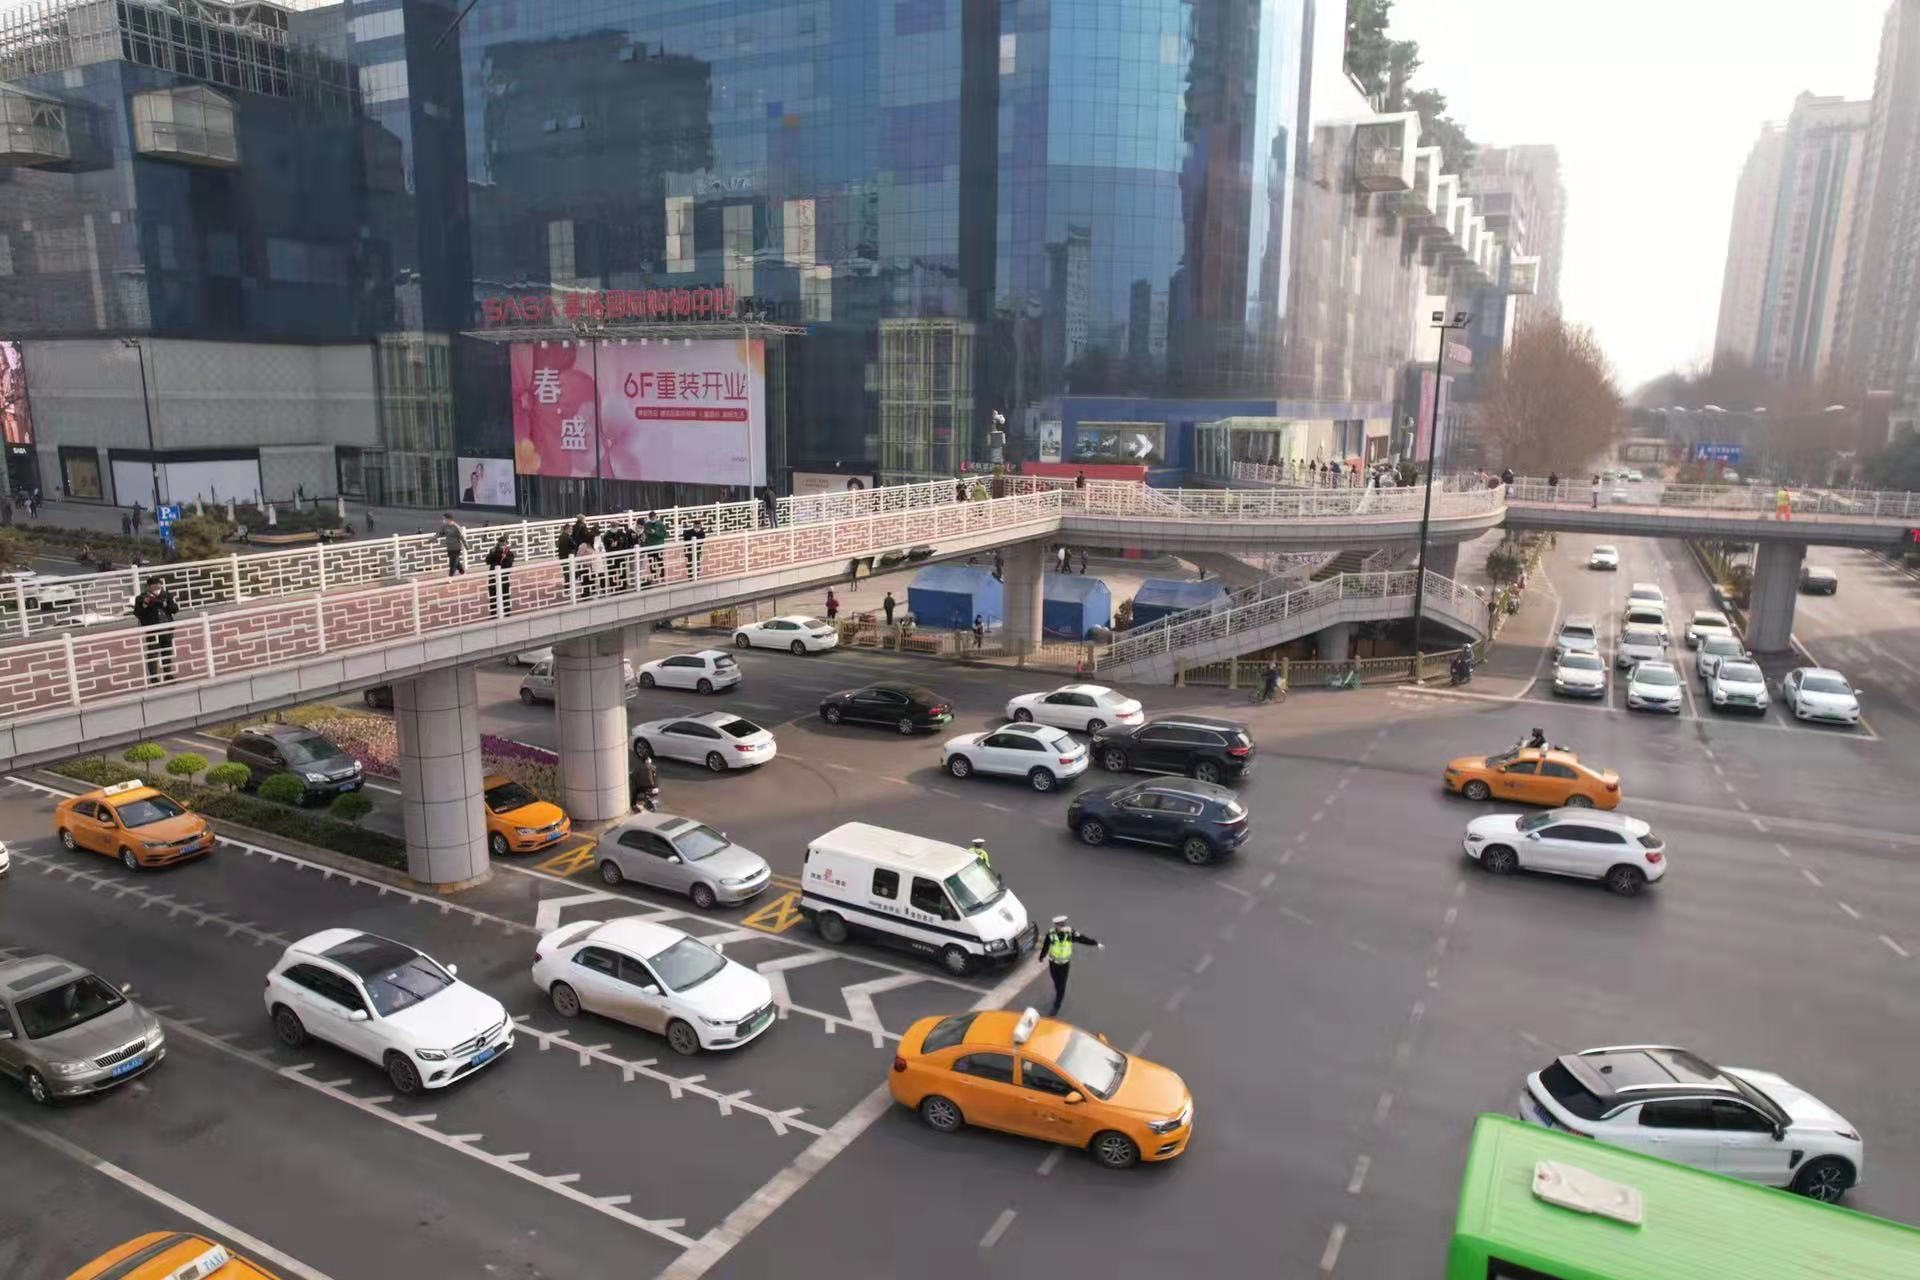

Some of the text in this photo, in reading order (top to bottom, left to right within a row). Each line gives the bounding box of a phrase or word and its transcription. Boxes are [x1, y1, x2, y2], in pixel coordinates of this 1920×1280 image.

[482, 296, 558, 321] SAGA
[624, 371, 748, 400] 6F重装开业
[533, 368, 587, 450] 春 盛
[161, 506, 170, 519] P
